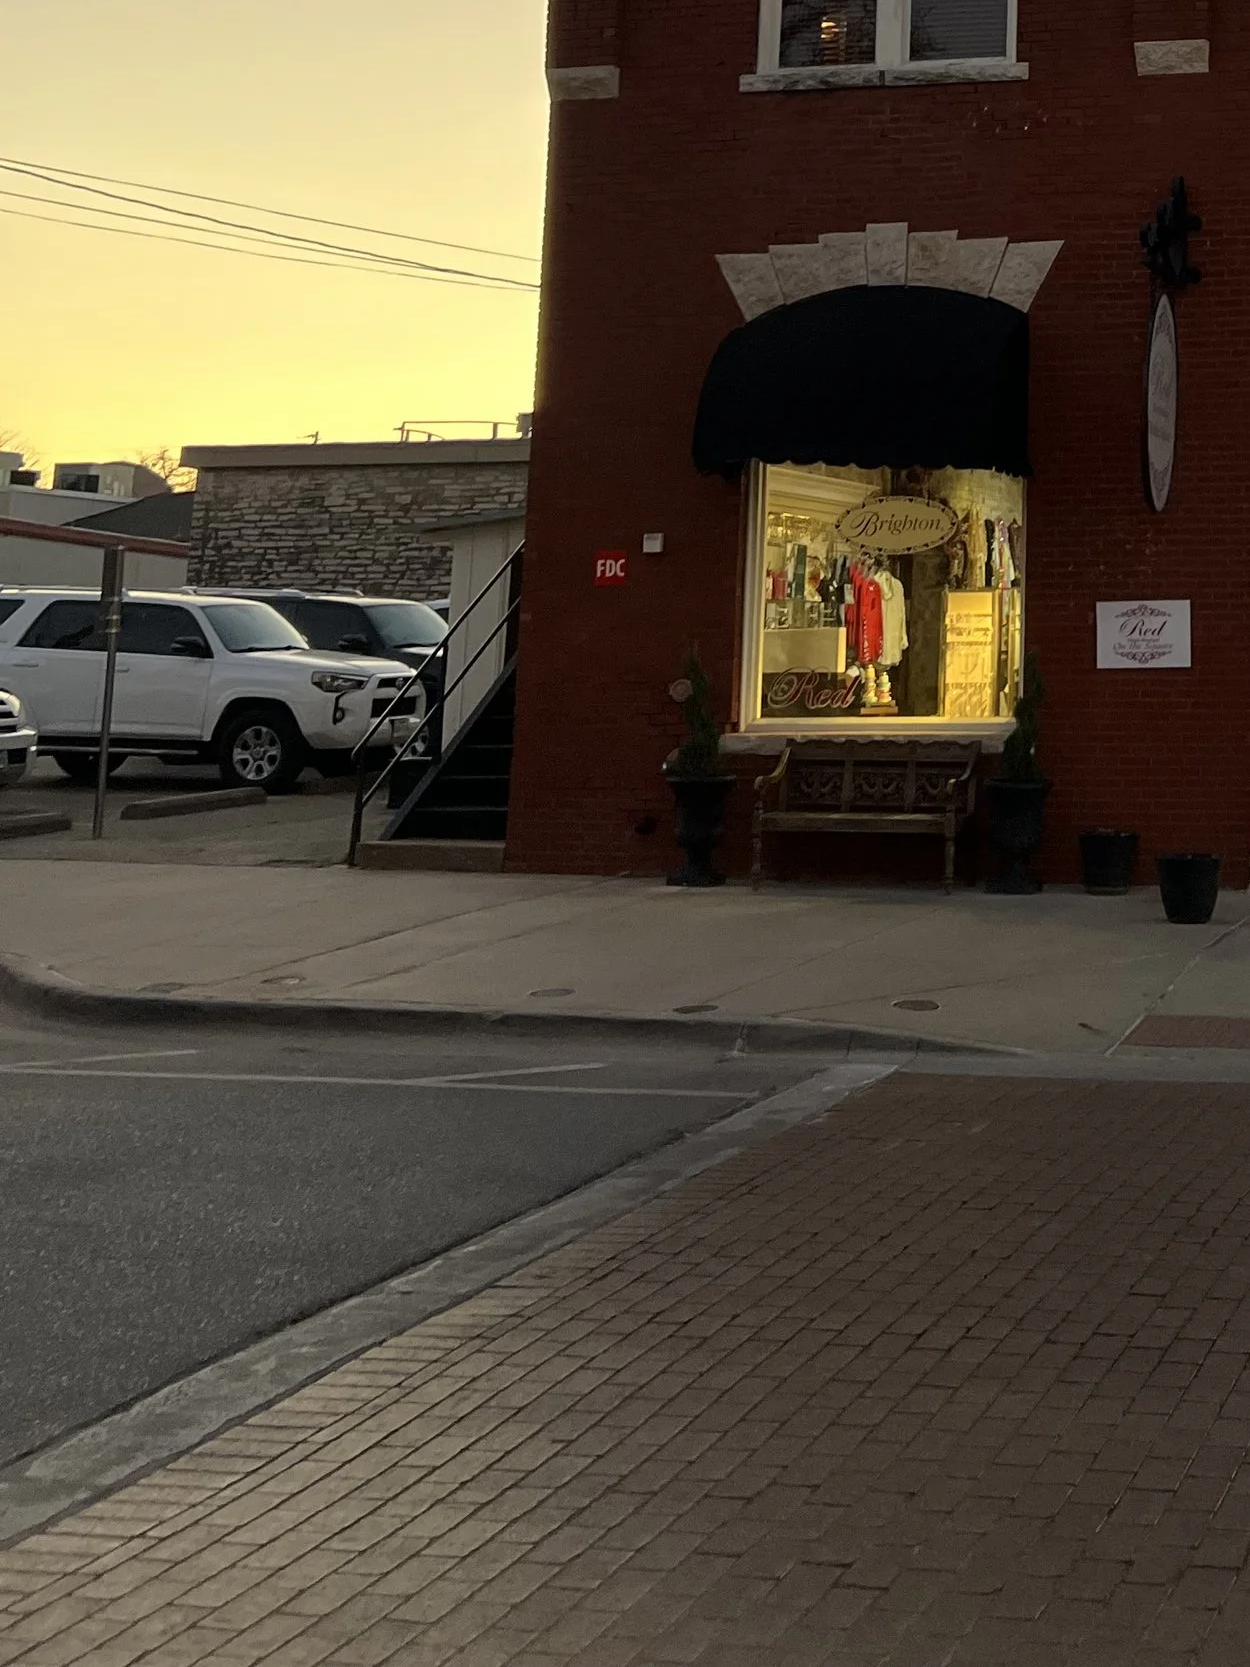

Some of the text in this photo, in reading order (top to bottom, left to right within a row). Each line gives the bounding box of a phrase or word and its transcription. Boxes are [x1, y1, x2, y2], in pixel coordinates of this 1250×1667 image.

[848, 511, 941, 538] Brighton
[596, 559, 626, 577] FDC
[1119, 619, 1167, 637] Red
[767, 666, 861, 709] Red
